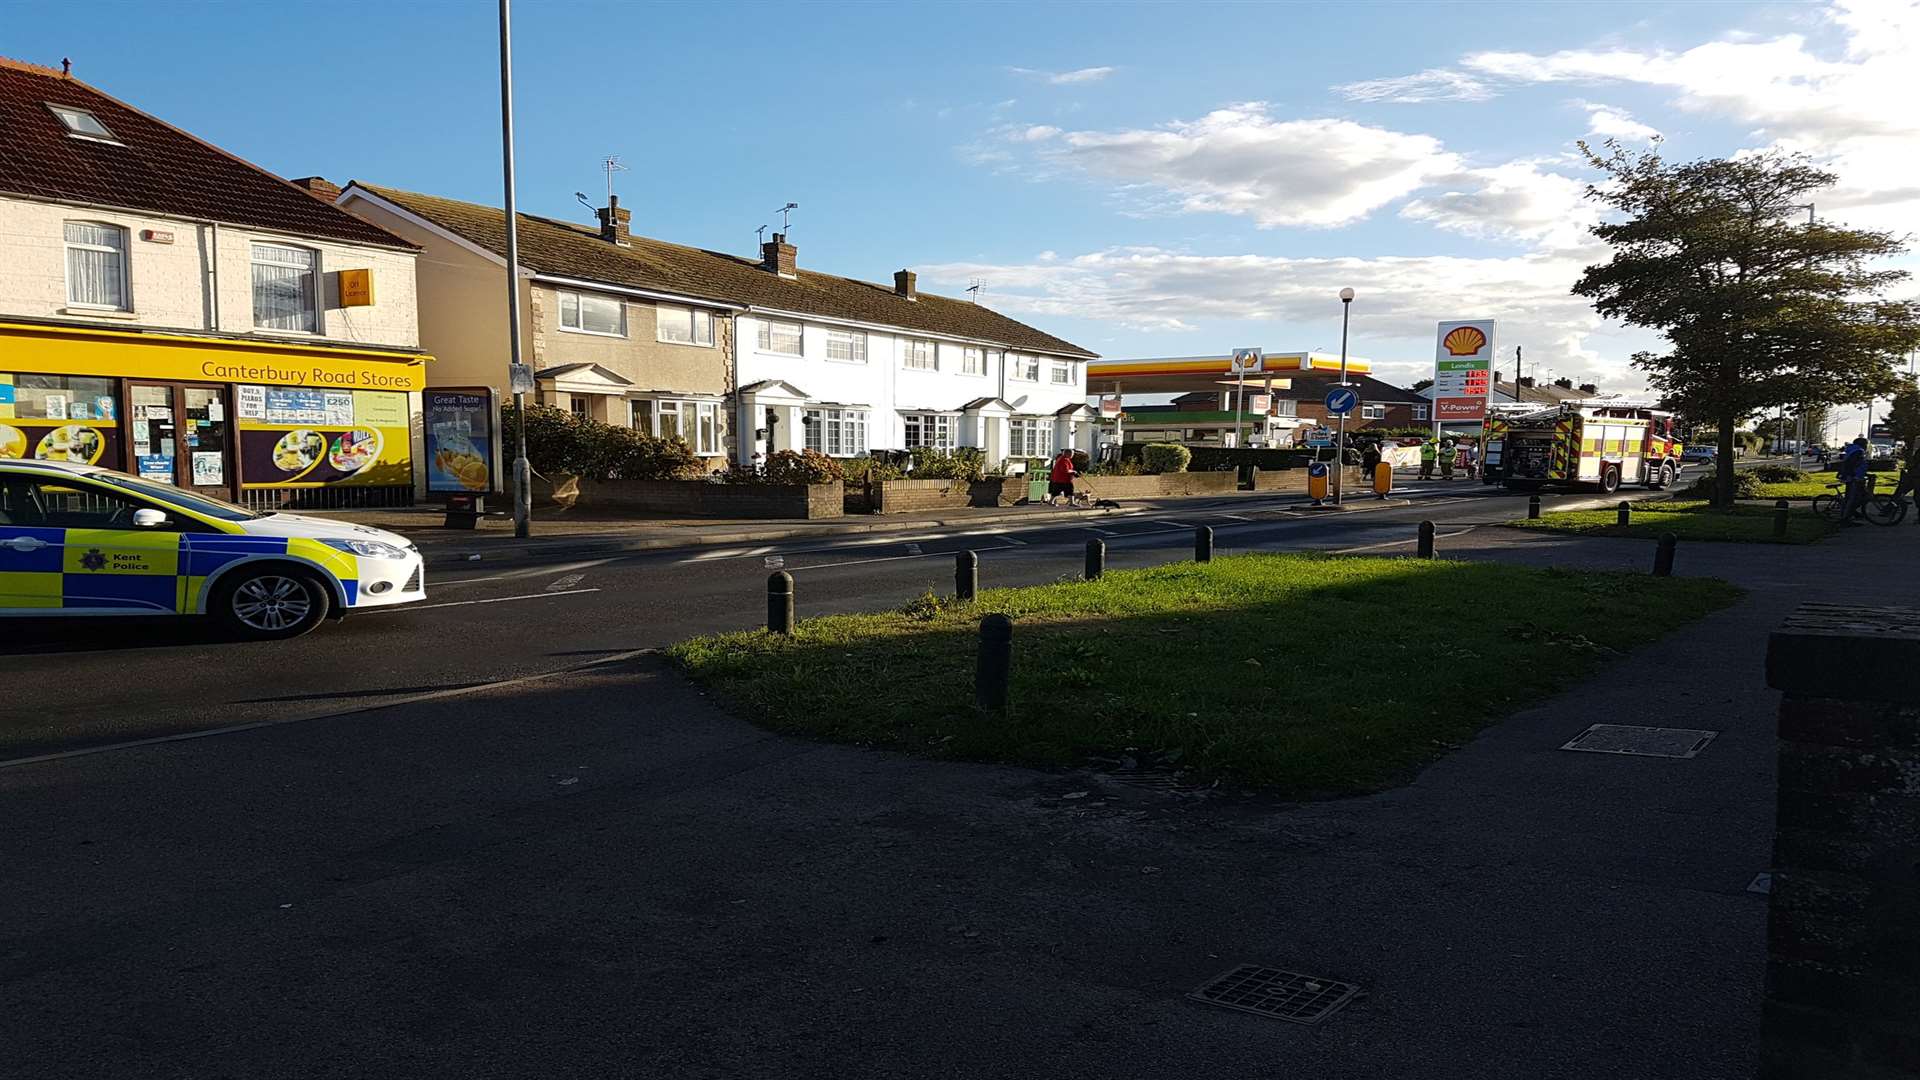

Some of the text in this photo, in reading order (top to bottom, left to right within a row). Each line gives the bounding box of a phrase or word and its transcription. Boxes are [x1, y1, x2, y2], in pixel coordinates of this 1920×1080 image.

[201, 361, 412, 388] Canterbury Road Stores
[326, 398, 350, 406] £250
[433, 396, 479, 404] Great Taste
